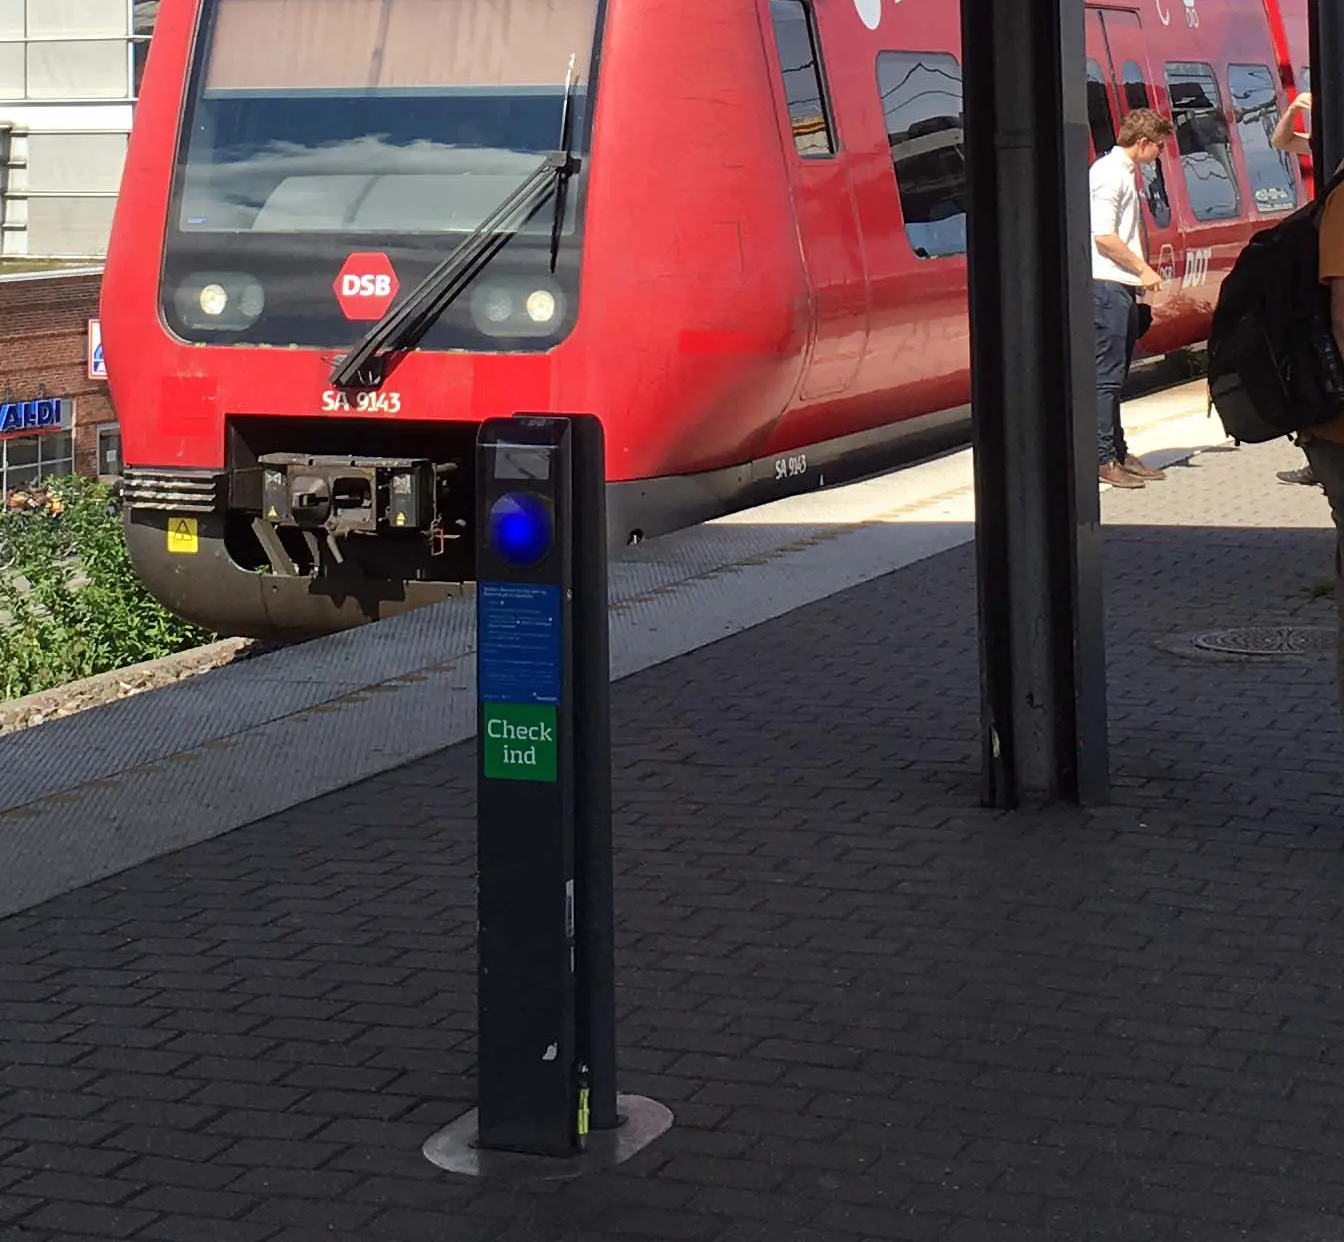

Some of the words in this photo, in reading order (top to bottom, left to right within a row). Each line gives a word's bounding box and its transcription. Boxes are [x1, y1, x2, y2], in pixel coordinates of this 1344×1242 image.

[341, 273, 391, 297] DSB
[321, 390, 350, 412] SA
[356, 390, 401, 414] 9143
[775, 458, 788, 480] SA
[487, 718, 553, 742] Check
[503, 744, 537, 765] ind
